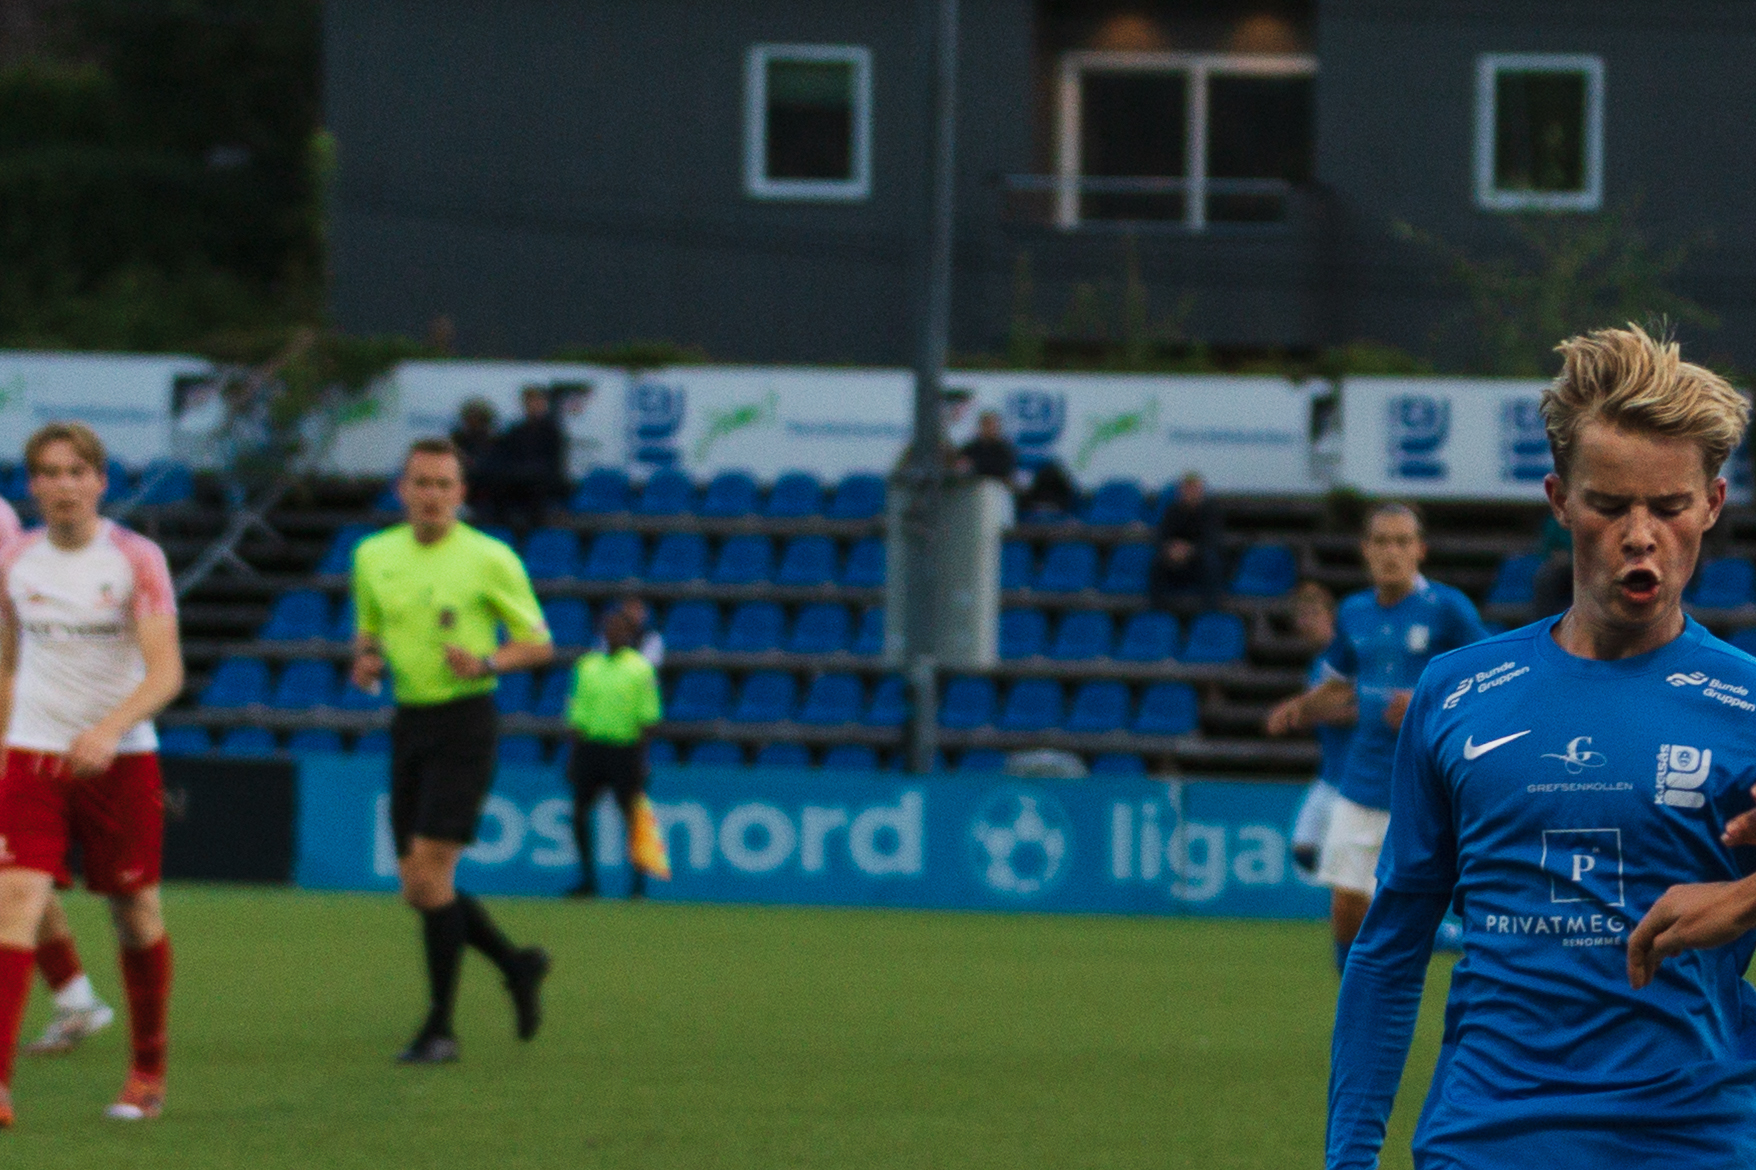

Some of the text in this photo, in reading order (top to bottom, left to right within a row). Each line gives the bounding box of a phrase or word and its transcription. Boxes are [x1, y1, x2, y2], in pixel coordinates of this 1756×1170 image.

[1475, 661, 1516, 682] Bunde
[1477, 666, 1530, 693] Gruppen
[1708, 678, 1749, 697] Bunde
[1702, 688, 1756, 712] Gruppen
[1526, 781, 1634, 793] GREFSENKOLLEN
